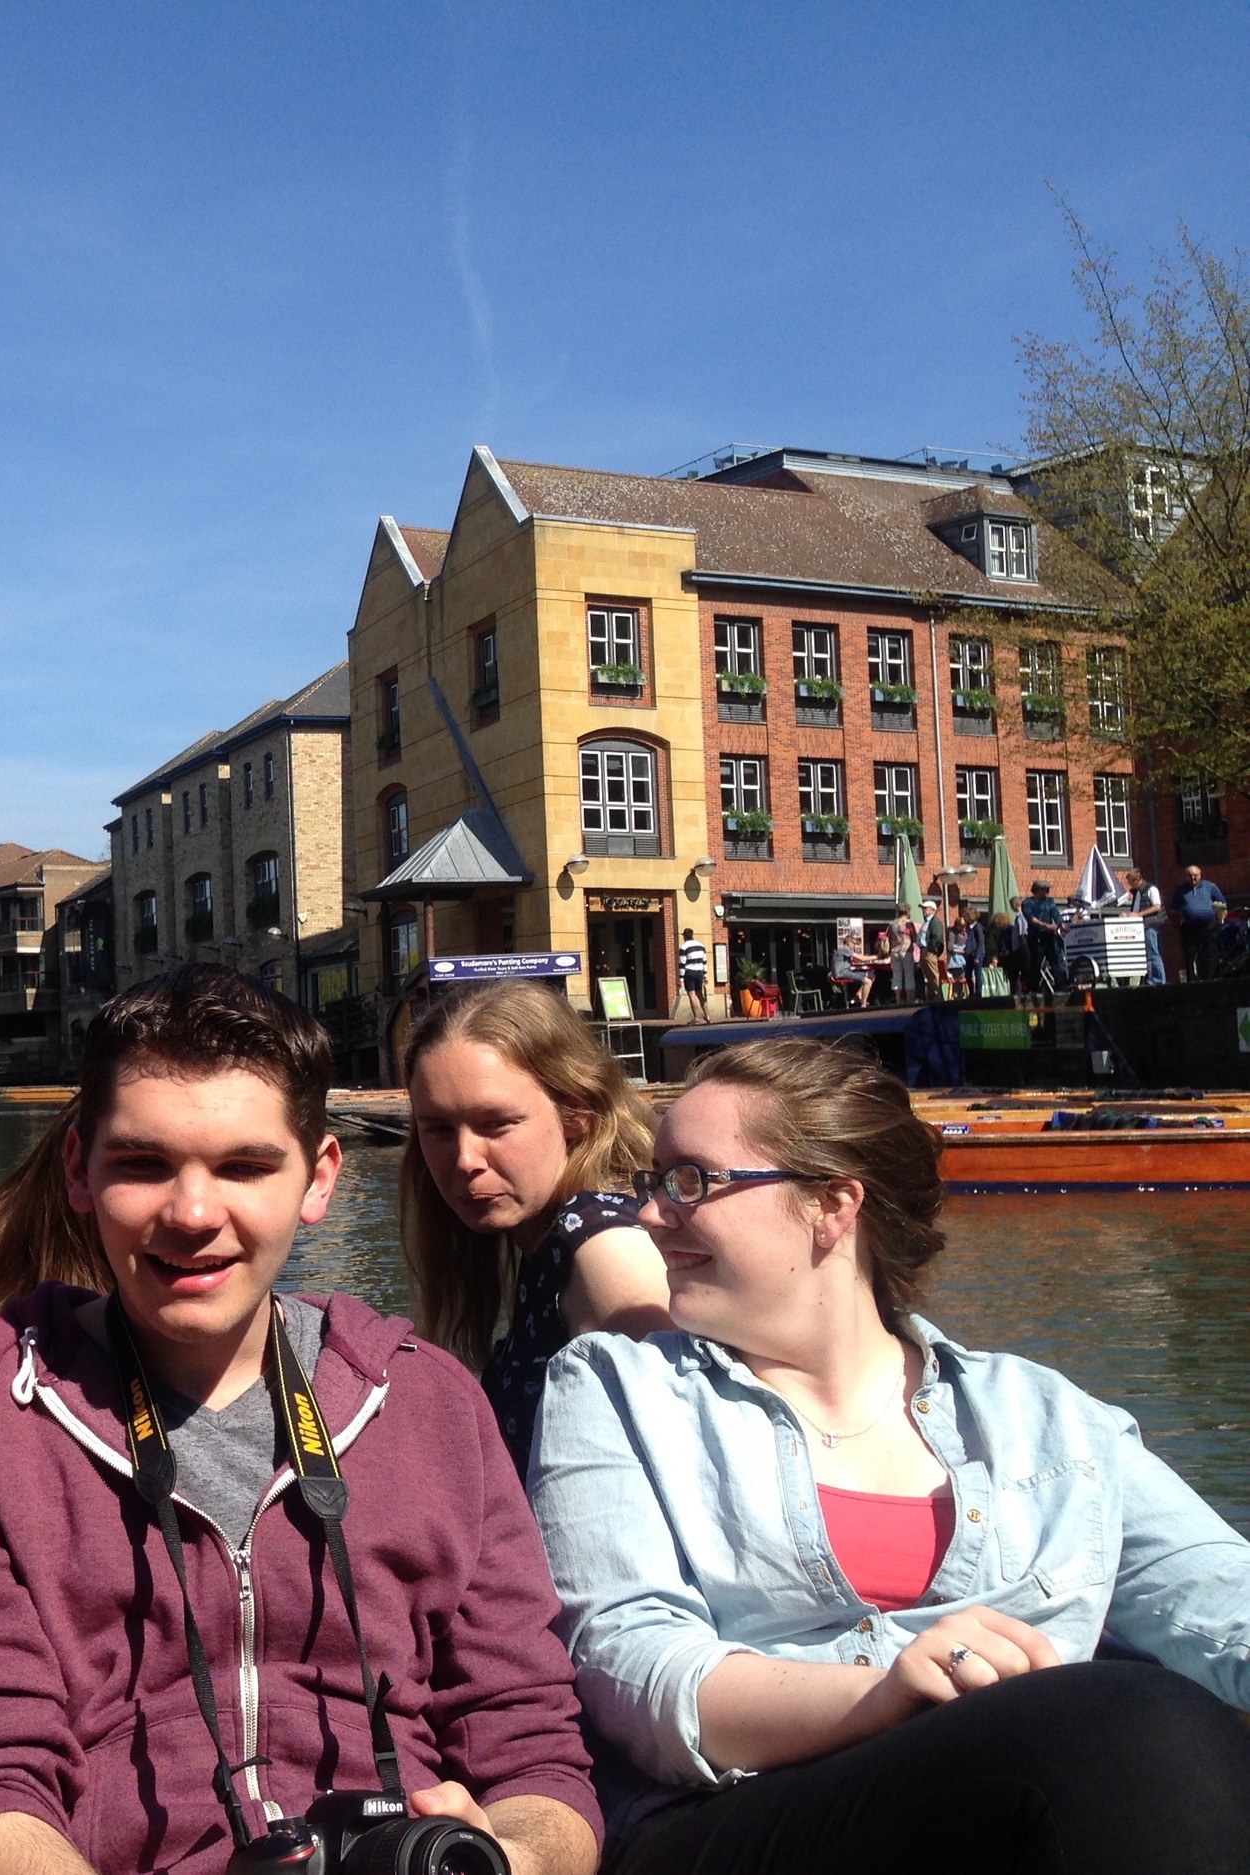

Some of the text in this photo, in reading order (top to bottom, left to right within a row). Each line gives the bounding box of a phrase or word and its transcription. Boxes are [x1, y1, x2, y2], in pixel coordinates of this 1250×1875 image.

[521, 957, 549, 965] Company
[960, 1022, 1027, 1037] PUBLIC ACCESS TO RIVER
[130, 1377, 154, 1441] Nikon
[294, 1392, 324, 1456] Nikon
[368, 1801, 403, 1813] Nikon
[459, 1832, 474, 1840] Nikon
